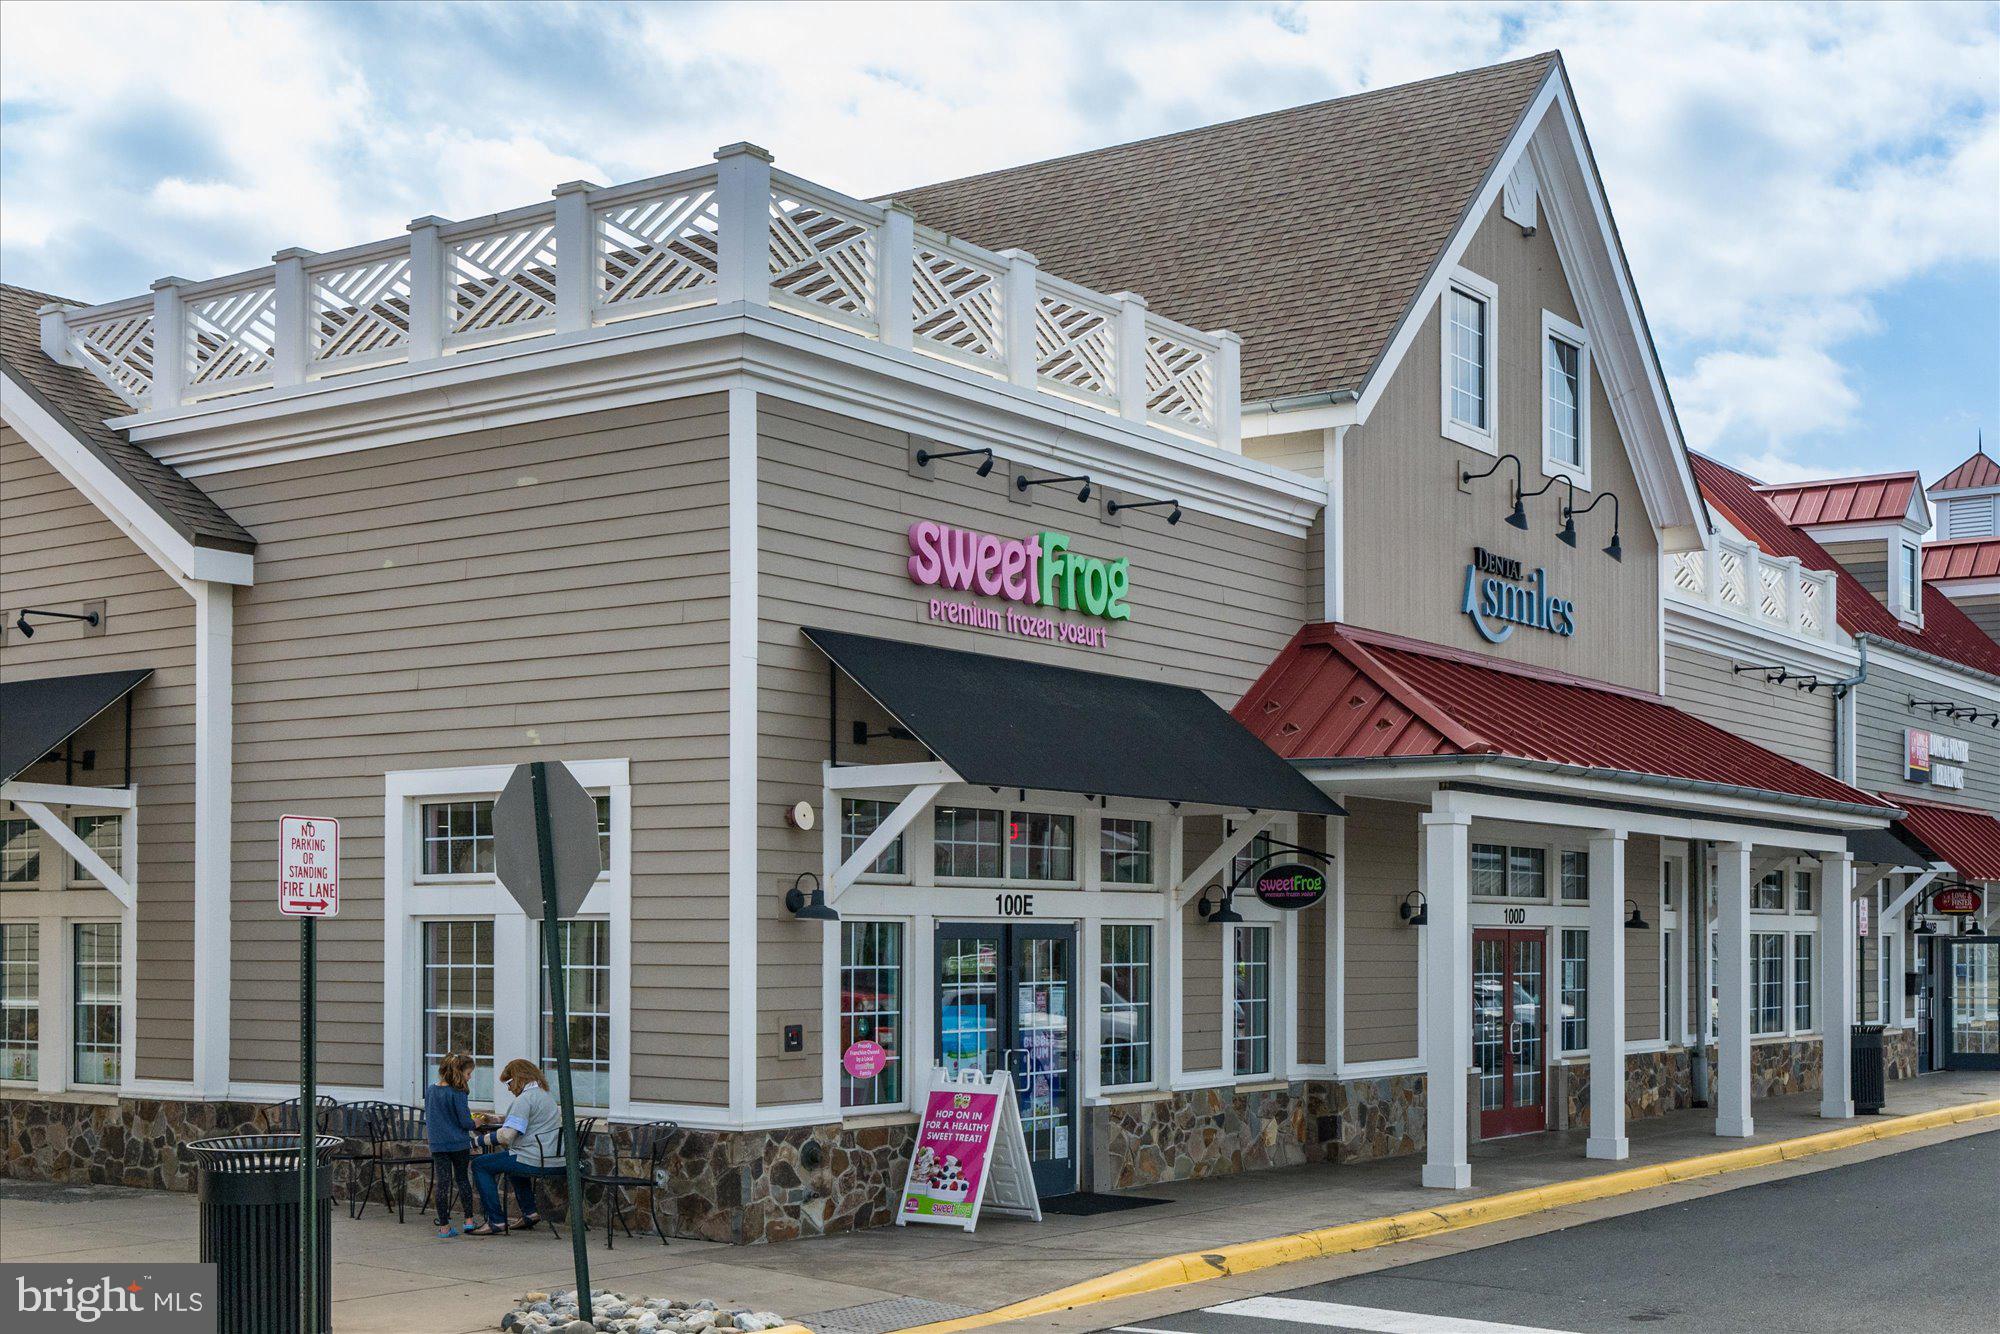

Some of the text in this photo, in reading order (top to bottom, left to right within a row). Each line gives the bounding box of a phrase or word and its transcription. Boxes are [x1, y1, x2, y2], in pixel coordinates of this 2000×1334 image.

[908, 520, 1131, 621] sweetFrog
[1474, 547, 1524, 581] DENTAL
[1481, 567, 1575, 637] smiles
[929, 598, 1108, 648] premium frozen yogurt
[301, 825, 316, 838] NO
[291, 838, 326, 852] PARKING
[302, 852, 314, 865] OR
[289, 866, 328, 879] STANDING
[283, 882, 336, 899] FIRE LANE
[1260, 875, 1322, 892] sweetFrog
[995, 894, 1034, 916] 100E
[1504, 908, 1526, 924] 100D
[935, 1110, 983, 1120] HOP ON IN
[925, 1121, 990, 1132] FOR A HEALTHY
[926, 1132, 983, 1143] SWEET TREAT!
